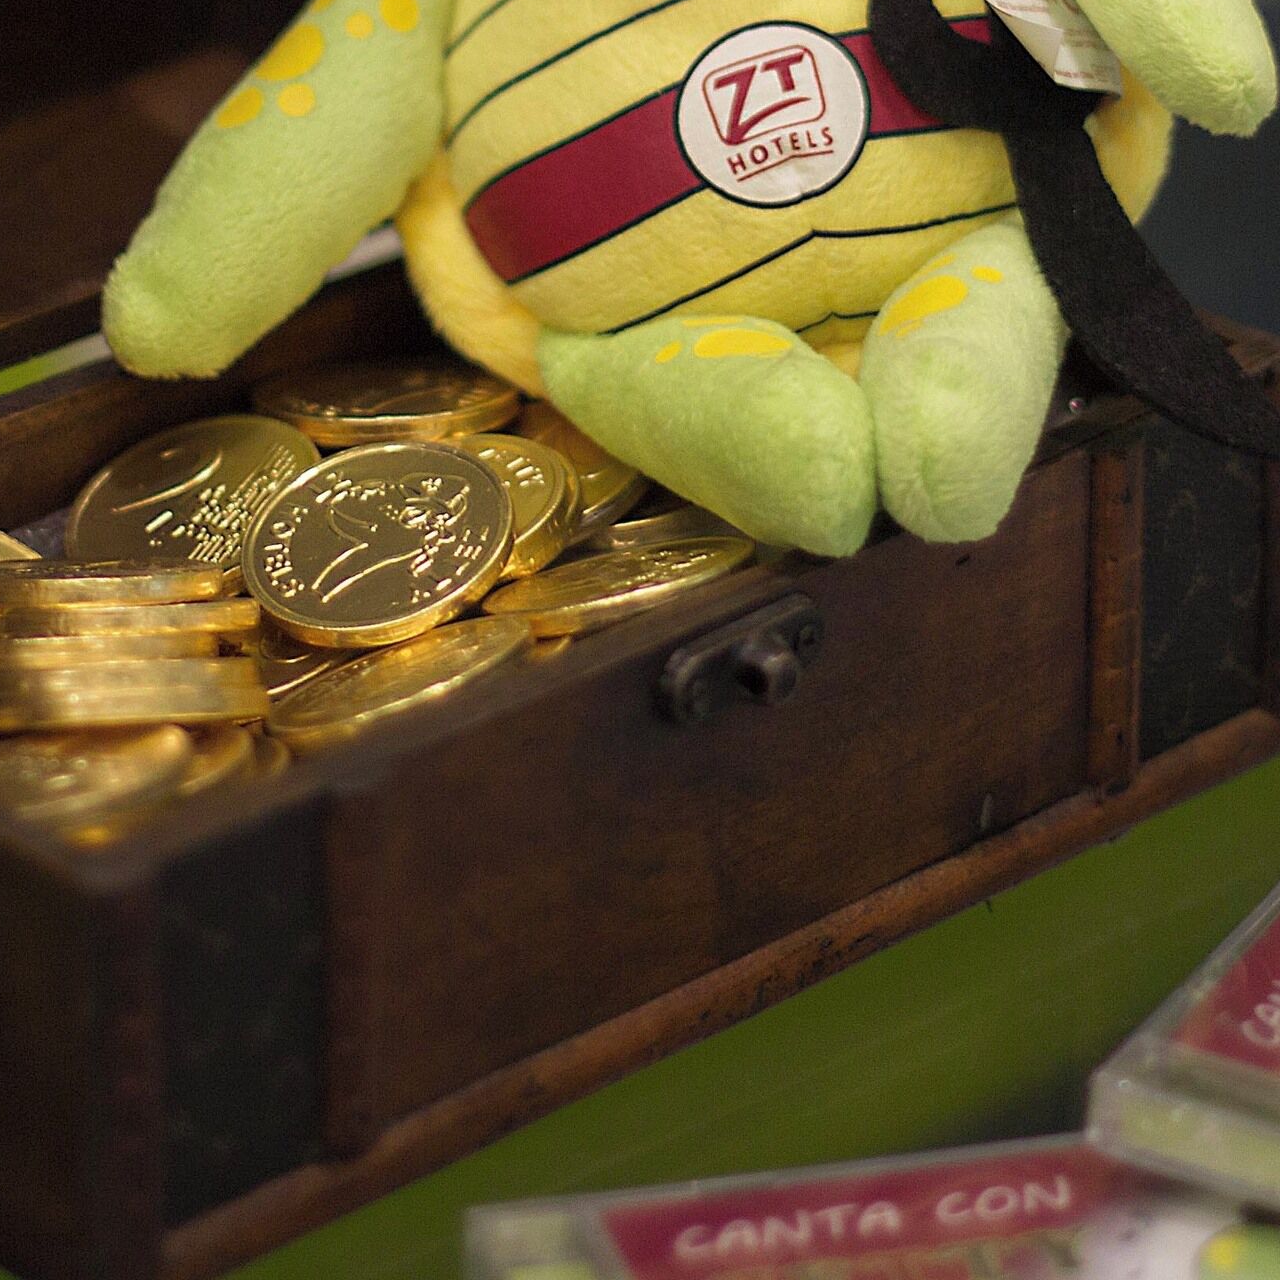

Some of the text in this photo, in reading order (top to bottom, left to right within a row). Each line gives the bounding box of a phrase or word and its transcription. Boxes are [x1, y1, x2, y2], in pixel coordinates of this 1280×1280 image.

[713, 51, 811, 145] ZT
[726, 126, 834, 175] HOTELS
[673, 1201, 903, 1262] CANTA
[936, 1174, 1072, 1224] CON
